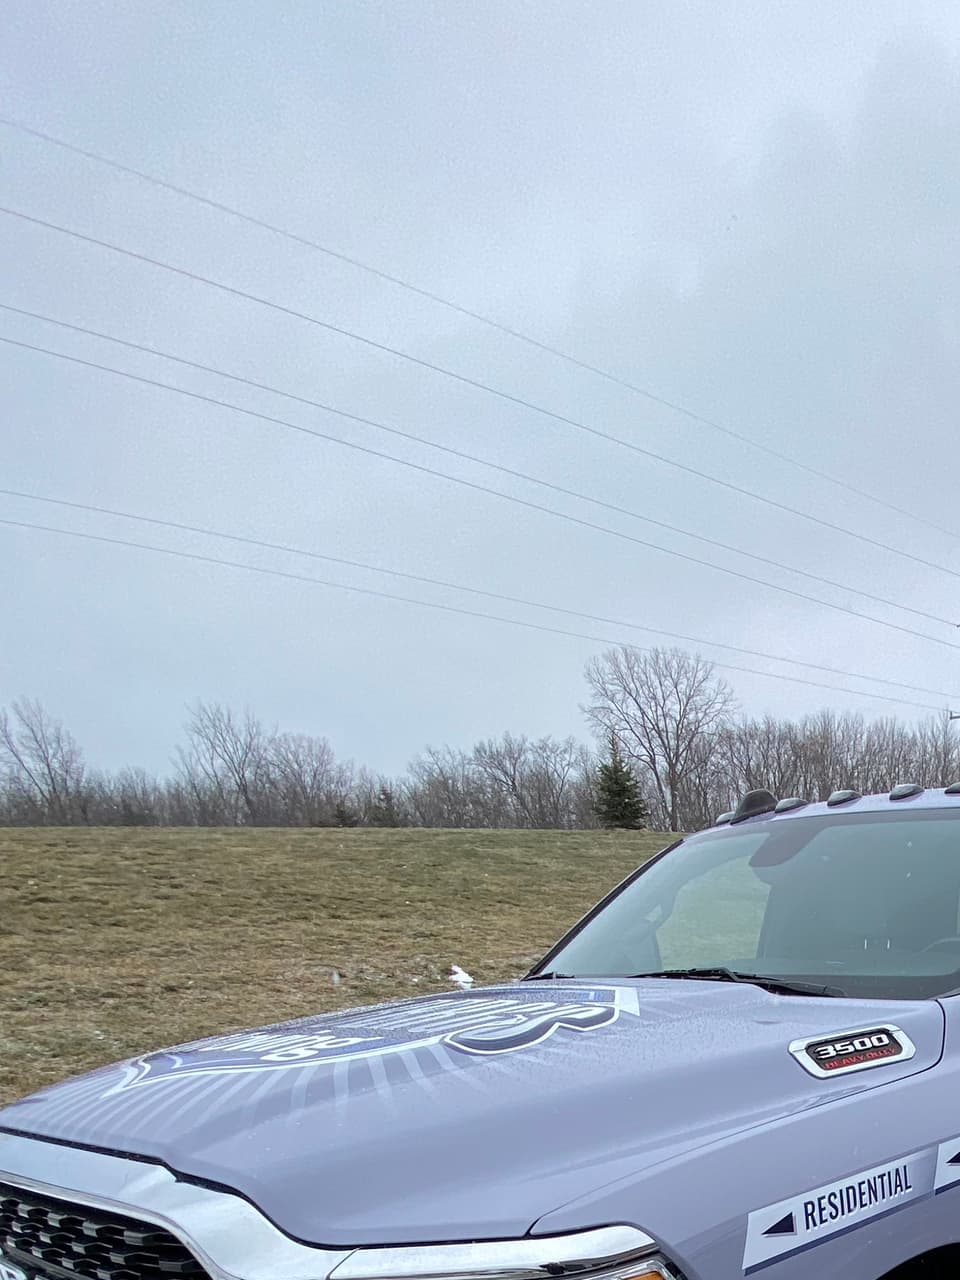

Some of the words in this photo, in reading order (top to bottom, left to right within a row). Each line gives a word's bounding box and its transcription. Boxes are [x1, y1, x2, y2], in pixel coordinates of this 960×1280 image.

[815, 1034, 890, 1059] 3500
[825, 1054, 864, 1069] HEAVY
[866, 1047, 895, 1060] DUTY
[803, 1164, 912, 1230] RESIDENTIAL
